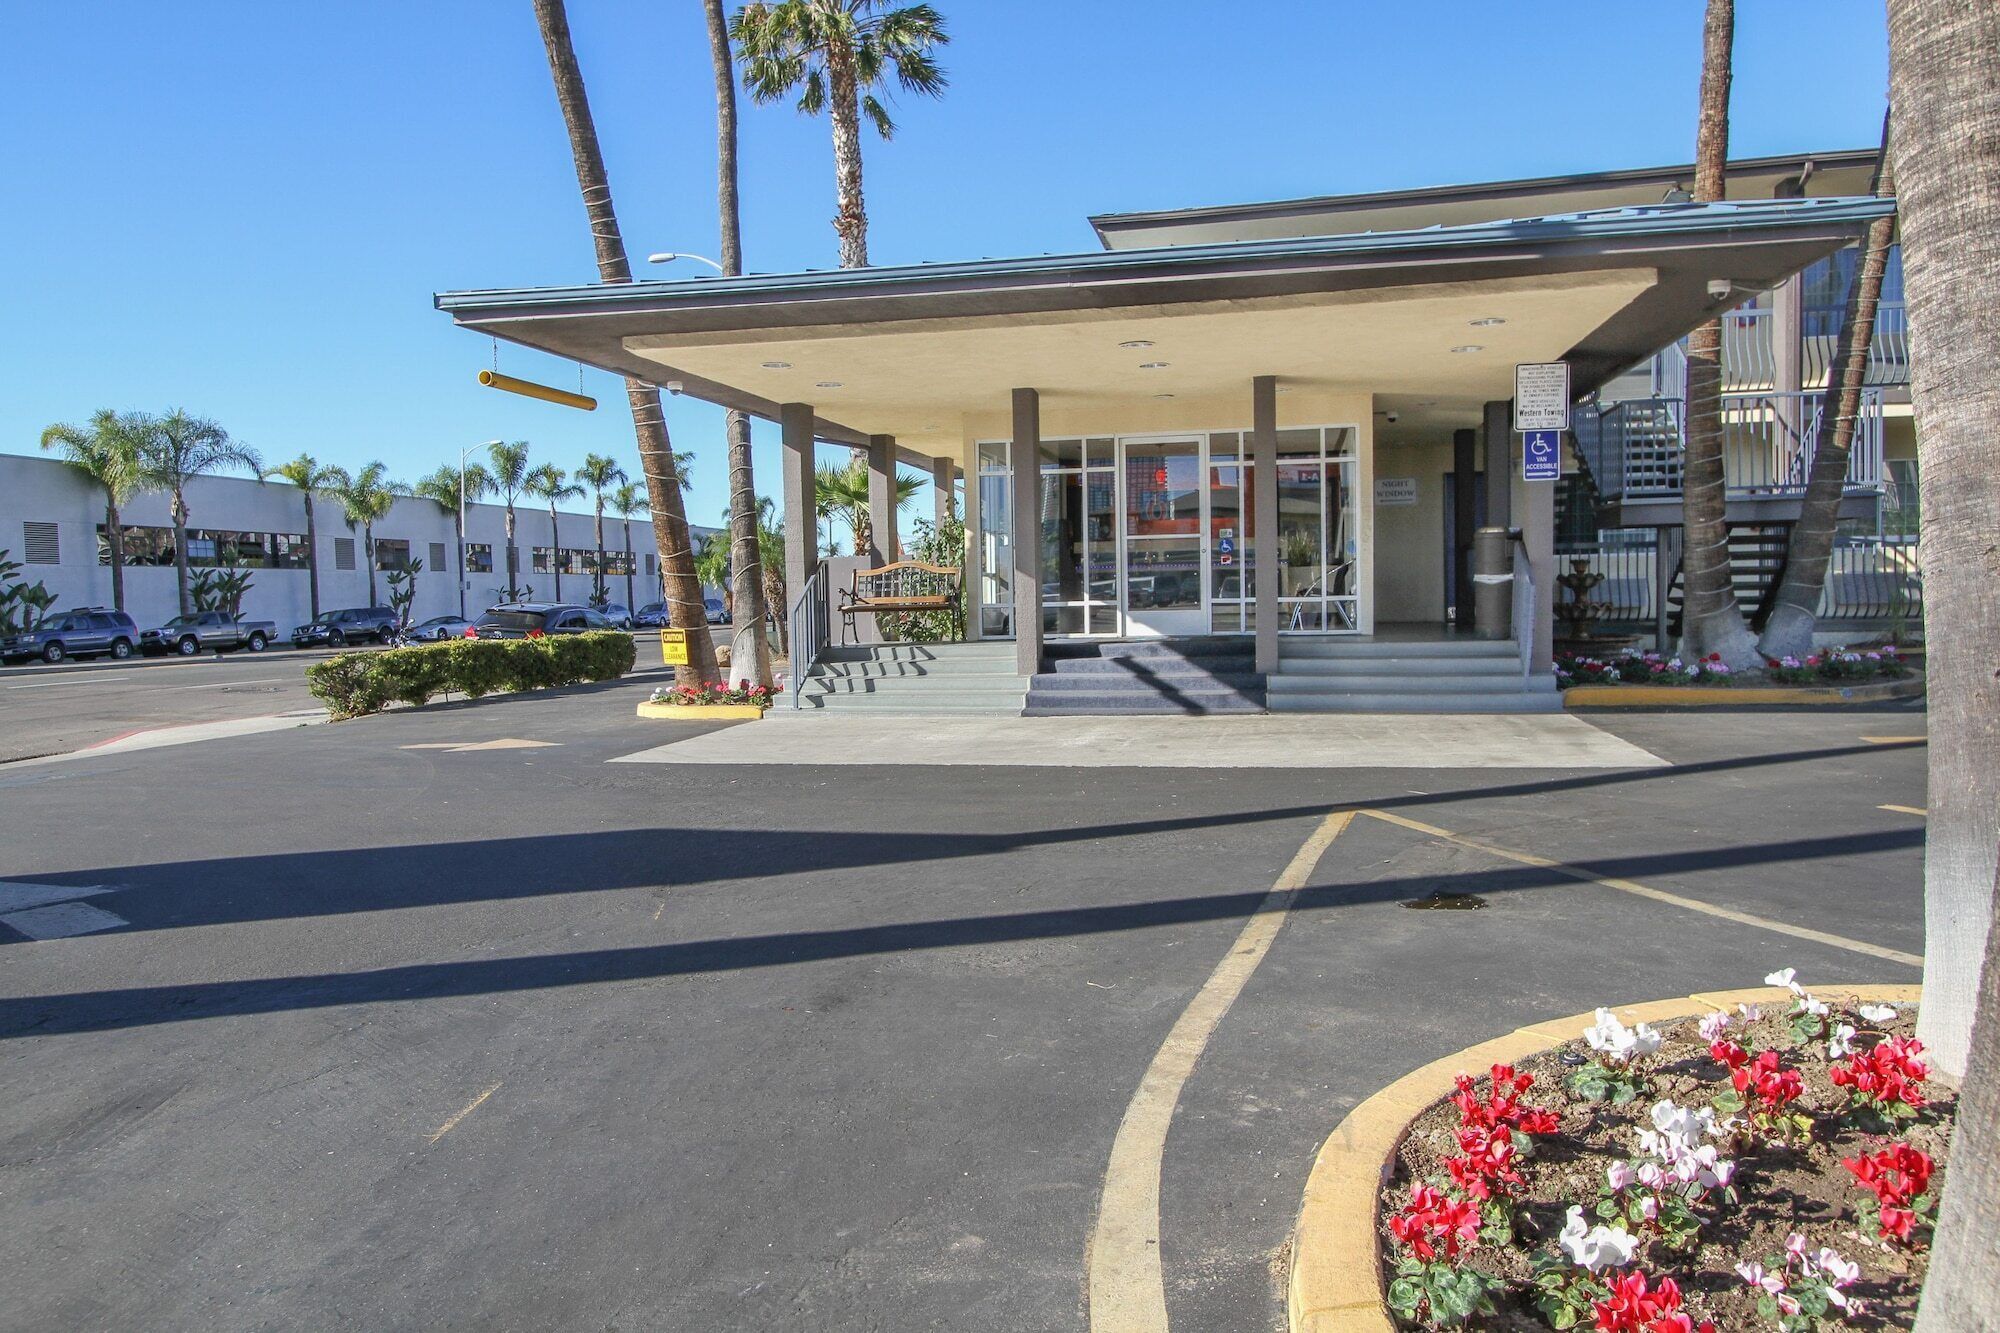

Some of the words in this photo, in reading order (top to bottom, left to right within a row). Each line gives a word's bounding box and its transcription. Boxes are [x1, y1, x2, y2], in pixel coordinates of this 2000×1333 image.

[1544, 408, 1565, 418] Towing
[1382, 480, 1408, 488] NIGHT
[664, 633, 683, 641] CAUTION
